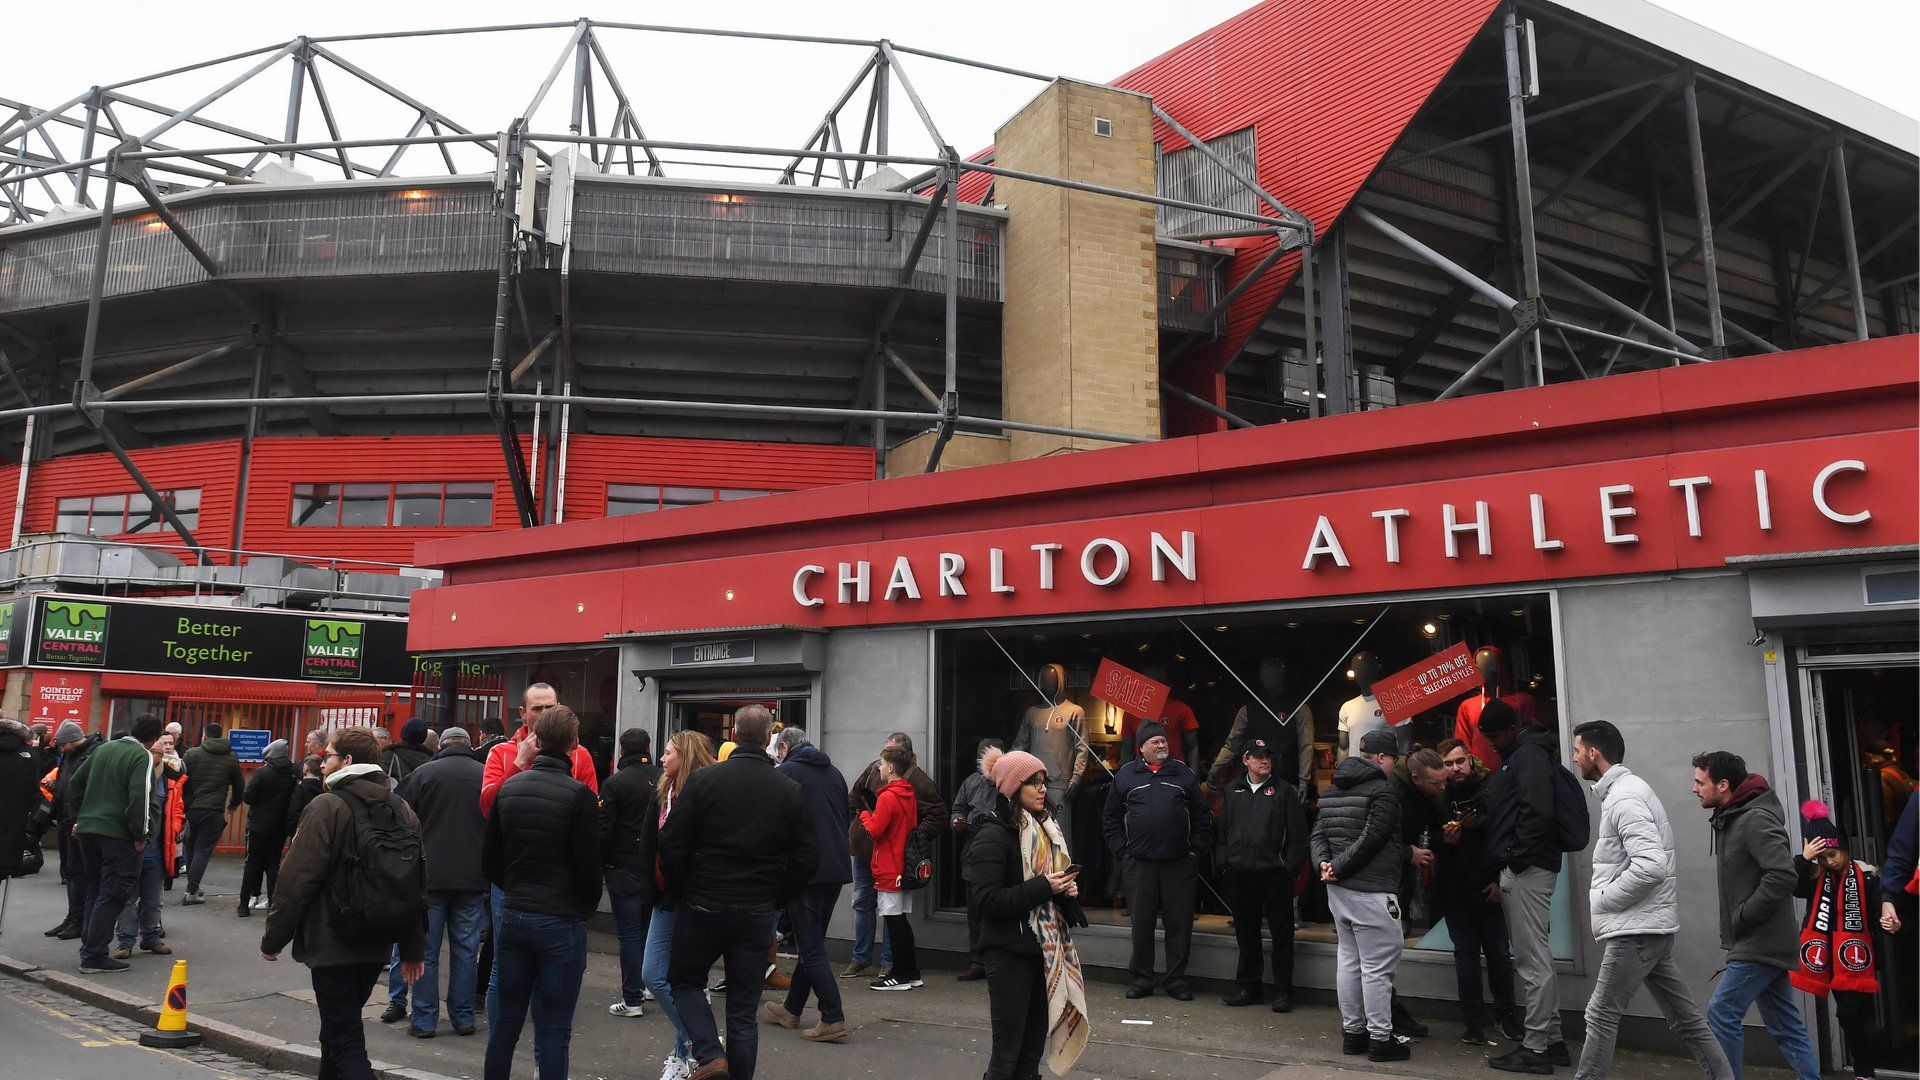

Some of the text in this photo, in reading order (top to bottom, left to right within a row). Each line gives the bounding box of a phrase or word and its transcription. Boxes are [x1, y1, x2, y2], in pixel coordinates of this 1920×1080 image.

[792, 460, 1872, 607] CHARLTON ATHLETIC
[46, 628, 103, 641] VALLEY
[177, 617, 242, 637] Better
[42, 641, 102, 653] CENTRAL
[162, 640, 253, 665] Together
[308, 645, 359, 657] VALLEY
[694, 643, 730, 662] ENTRANCE
[305, 657, 358, 668] CENTRAL
[411, 656, 490, 677] Togher
[1417, 653, 1469, 685] UP TO 70% OFF
[40, 686, 71, 694] POINTS
[1105, 669, 1155, 713] SALE
[1423, 666, 1475, 696] SELECTED STYLES
[41, 693, 82, 702] INTEREST
[1379, 678, 1423, 714] SALE
